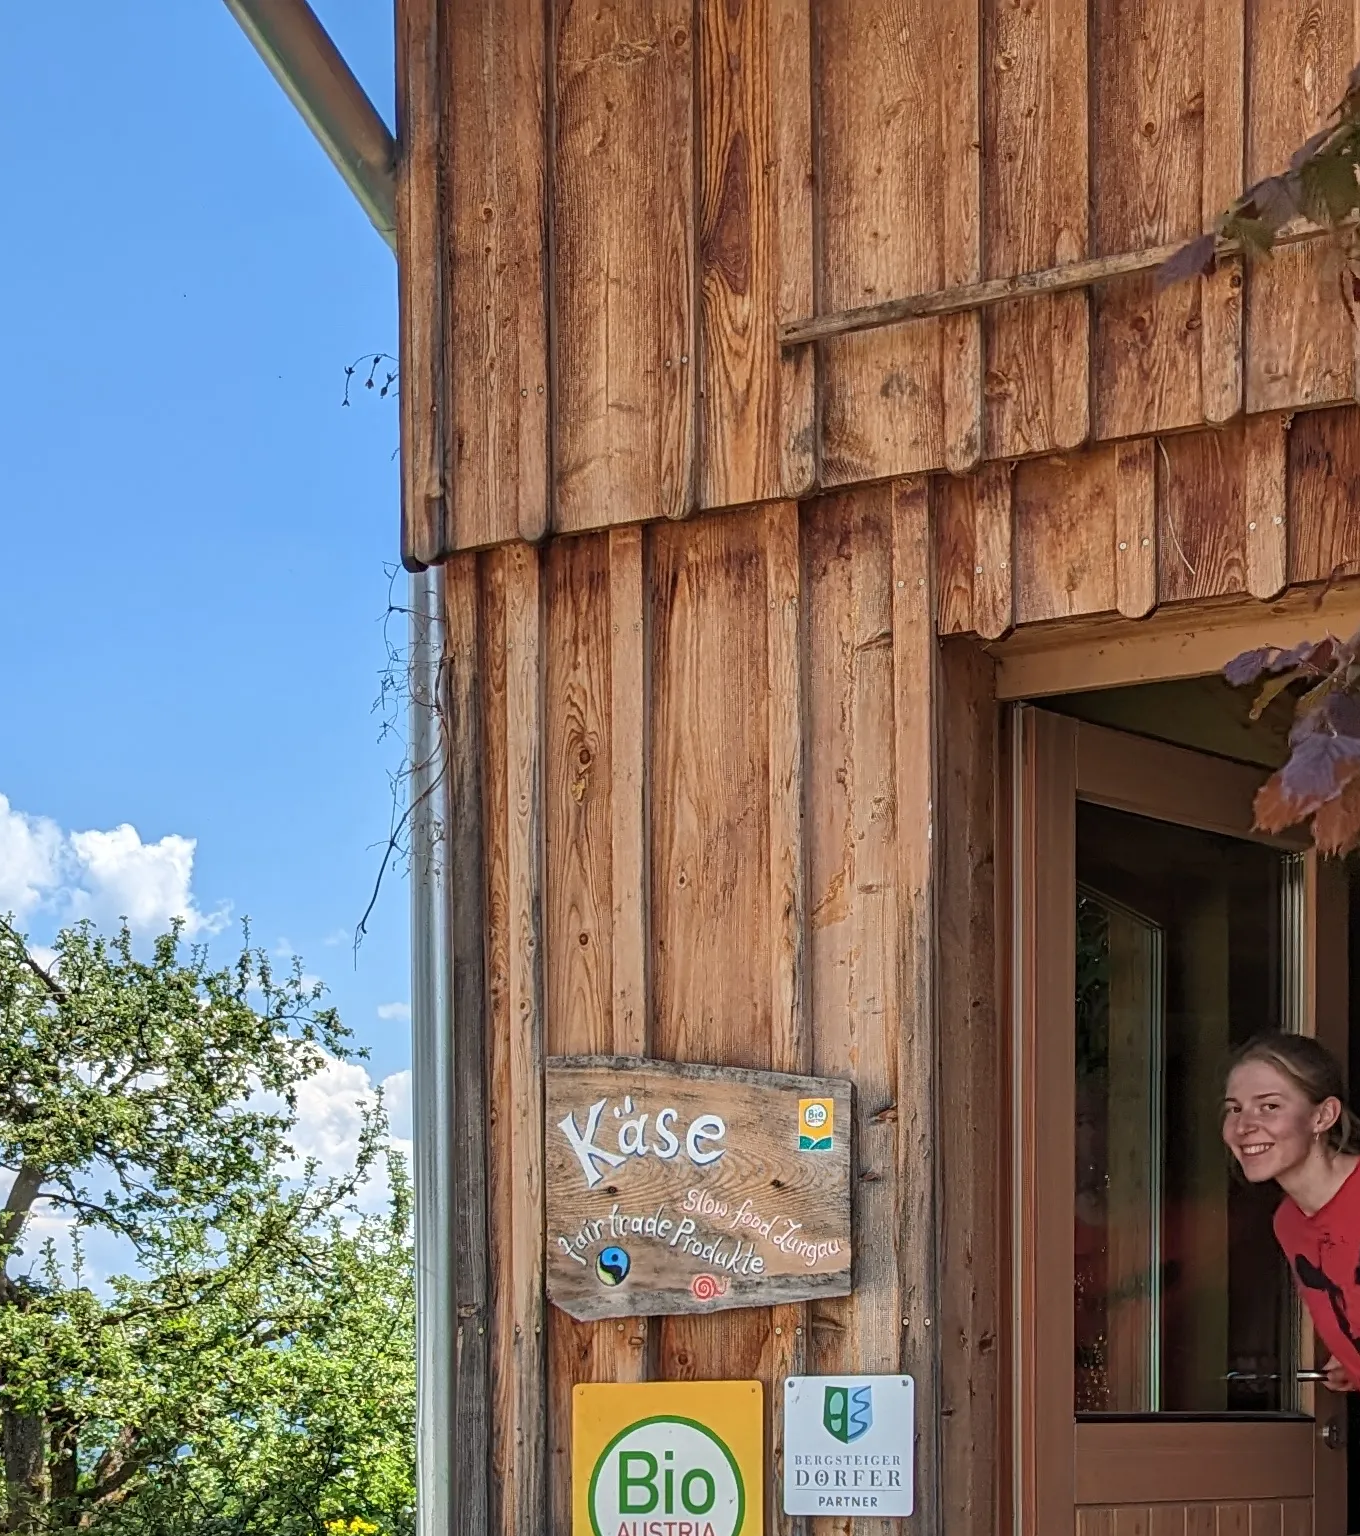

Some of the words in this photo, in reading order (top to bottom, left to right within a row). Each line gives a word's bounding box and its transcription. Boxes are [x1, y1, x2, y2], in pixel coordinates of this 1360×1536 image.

[557, 1095, 727, 1189] Käse
[682, 1189, 729, 1218] Slow
[729, 1199, 781, 1240] food
[669, 1215, 766, 1275] Produkte
[618, 1450, 716, 1515] Bio
[794, 1455, 901, 1466] BERGSTEIGER
[818, 1496, 878, 1507] PARTNER
